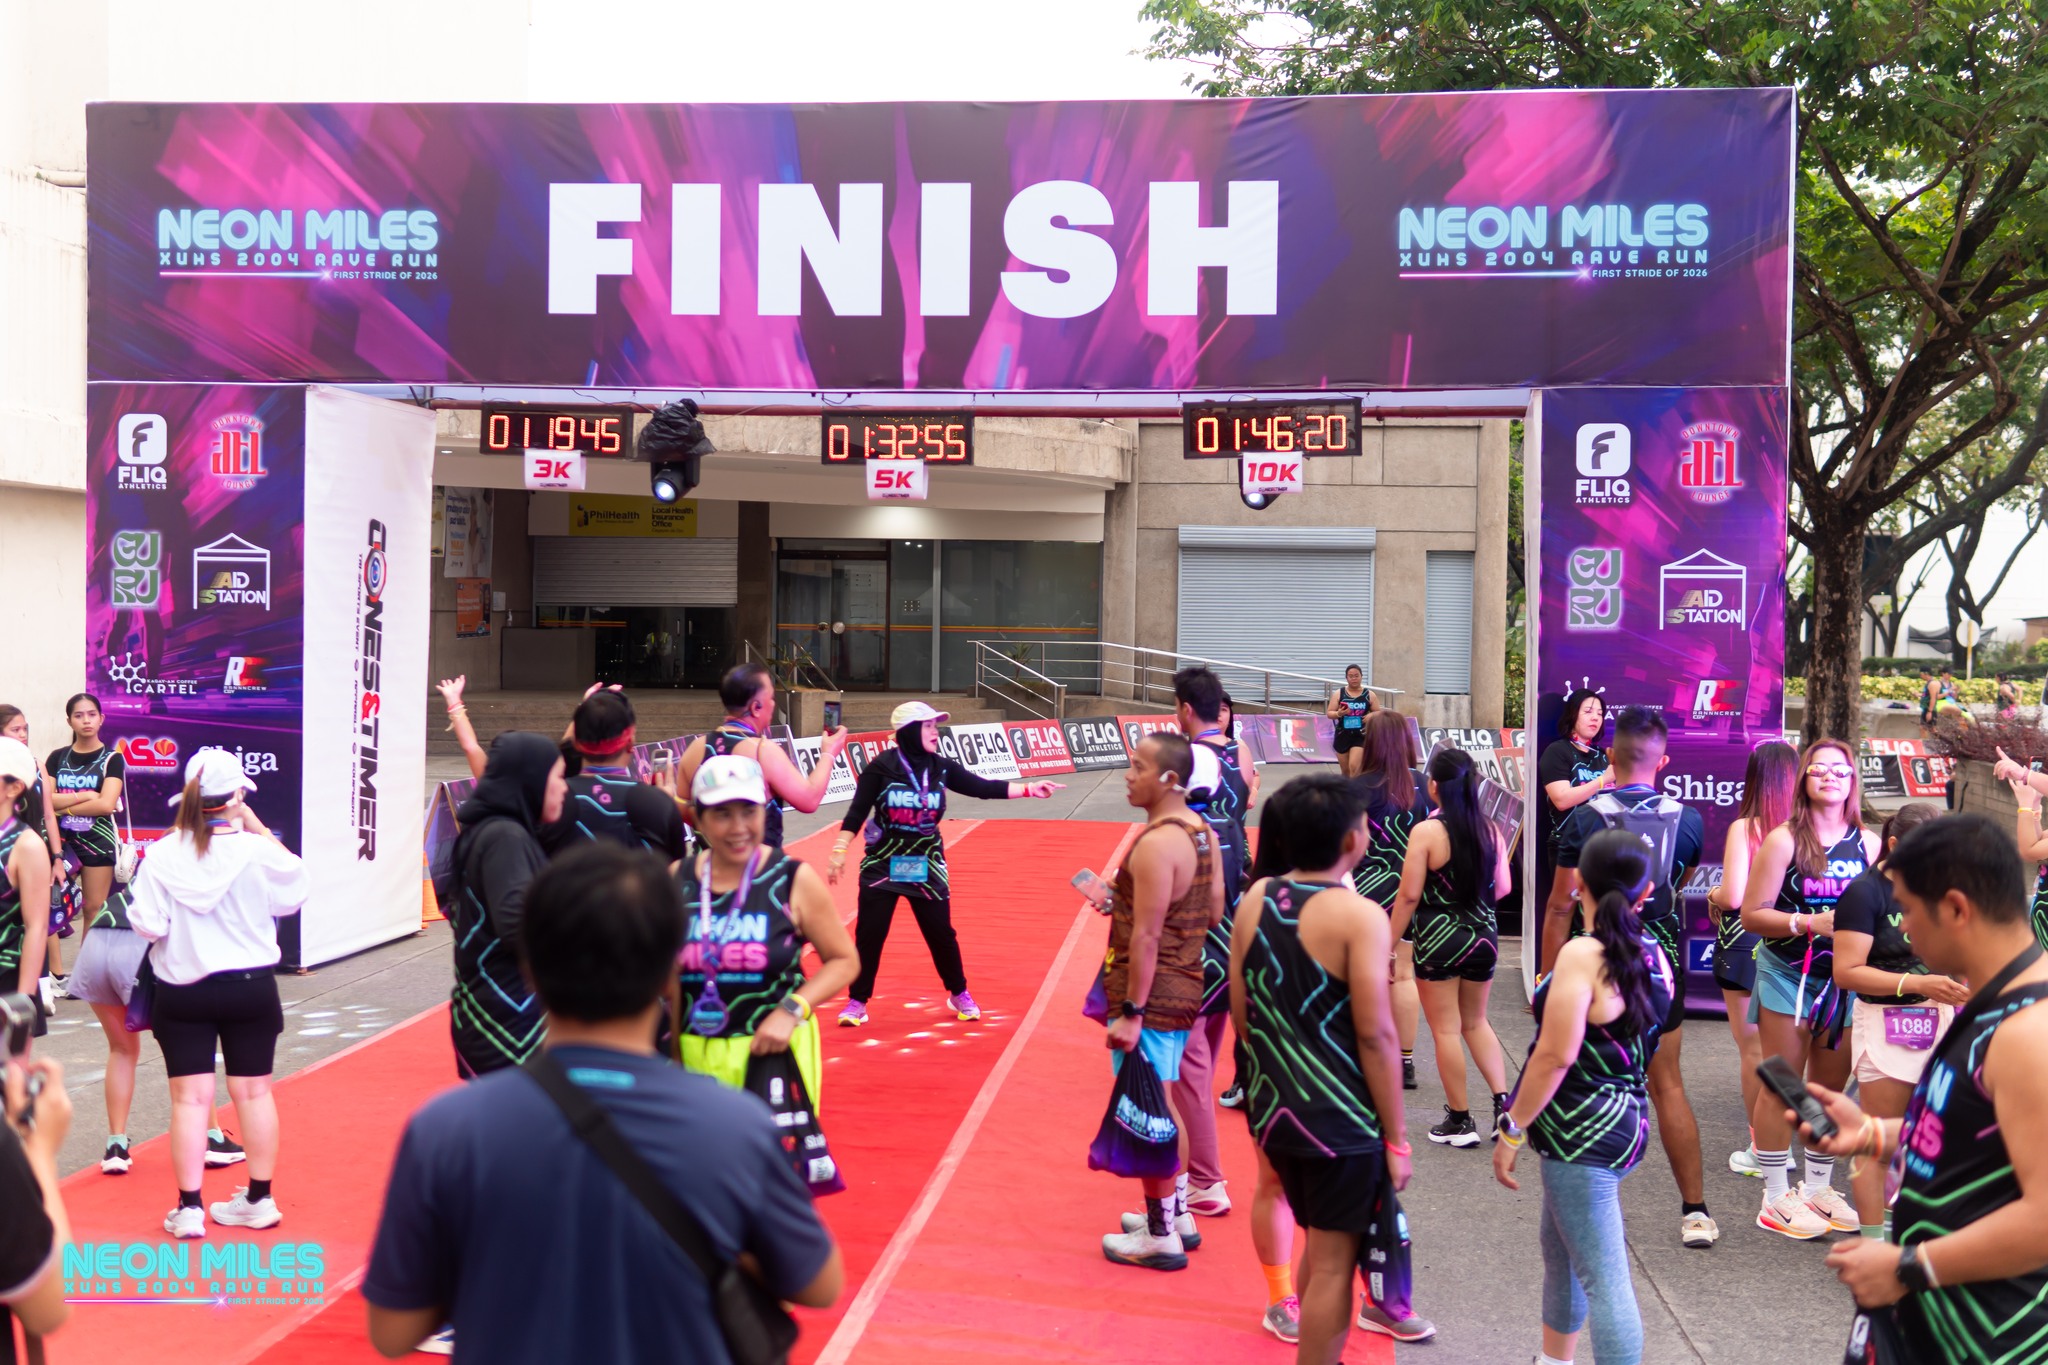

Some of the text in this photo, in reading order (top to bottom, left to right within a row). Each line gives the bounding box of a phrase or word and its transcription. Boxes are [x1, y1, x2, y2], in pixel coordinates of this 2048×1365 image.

[158, 208, 438, 251] NEON MILES
[1398, 203, 1709, 249] NEON MILES
[548, 180, 1279, 318] FINISH
[160, 252, 438, 267] XUHS 2004 RAVE RUN
[1400, 249, 1708, 266] XUHS 2004 RAVE RUN
[333, 271, 438, 280] FIRST STRIDE OF 2026
[1592, 268, 1708, 278] FIRST STRIDE OF 2026
[212, 414, 264, 430] DOWNTOWN
[1682, 422, 1740, 439] DOWNTOWN
[118, 466, 167, 483] FLIQ
[533, 459, 573, 478] 3K
[1248, 462, 1299, 482] 10K
[221, 477, 256, 490] LOUNGE
[874, 469, 915, 489] 5K
[1575, 479, 1630, 497] FLIQ
[1691, 489, 1730, 503] LOUNGE
[590, 510, 640, 520] PhilHealth
[210, 571, 250, 589] AID
[200, 589, 267, 604] STATION
[1678, 589, 1723, 607] AID
[1666, 609, 1741, 624] STATION
[133, 683, 197, 694] CARTEL
[1025, 726, 1065, 749] FLIQ
[1081, 722, 1120, 745] FLIQ
[1448, 729, 1493, 746] FLIQ
[973, 732, 1008, 755] FLIQ
[1088, 743, 1123, 752] ATHLETICS
[1871, 740, 1916, 755] FLIQ
[981, 754, 1012, 763] ATHLETICS
[1033, 748, 1067, 757] ATHLETICS
[1085, 755, 1094, 763] THE
[1095, 754, 1128, 762] UNDETERRED
[989, 765, 1017, 775] UNDETERRED
[1030, 761, 1039, 769] THE
[1040, 759, 1072, 768] UNDETERRED
[57, 774, 98, 788] NEON
[1892, 1017, 1933, 1035] 1088
